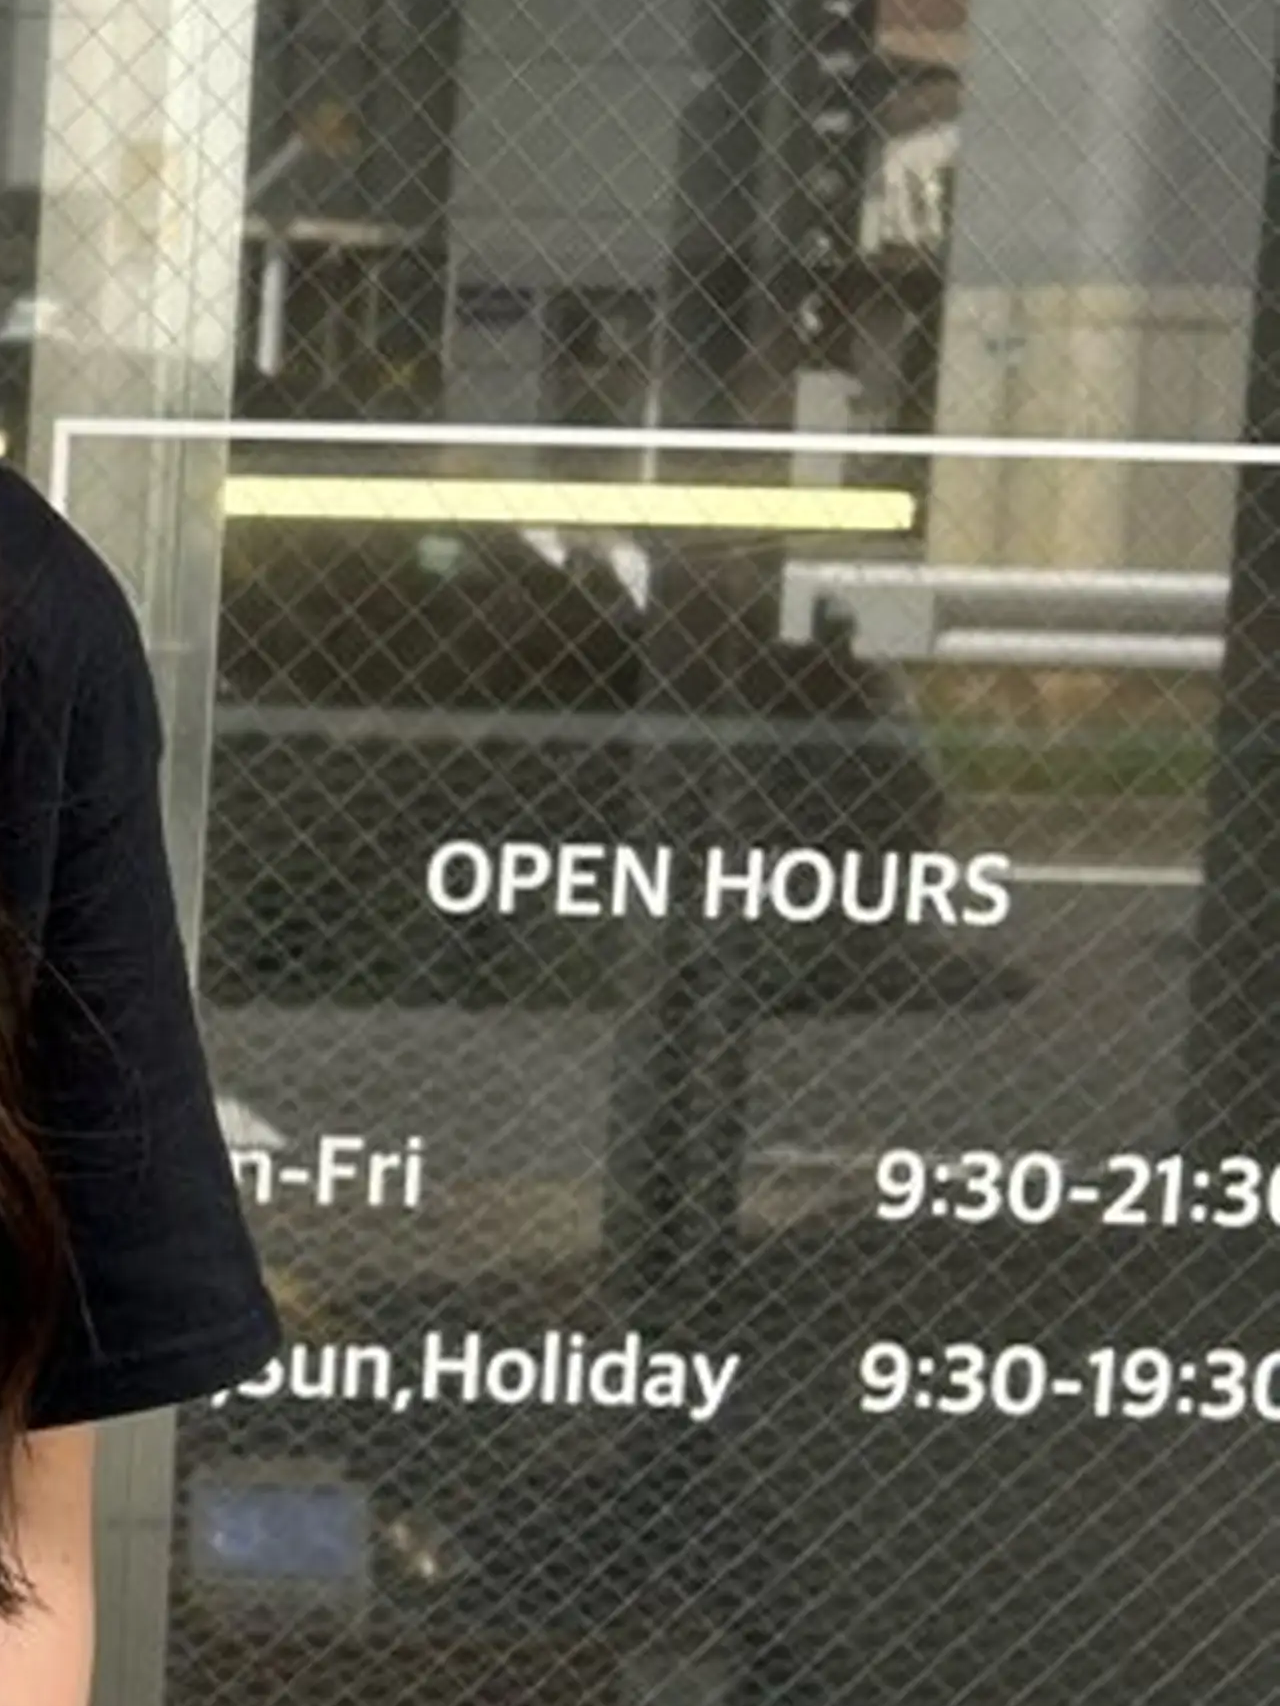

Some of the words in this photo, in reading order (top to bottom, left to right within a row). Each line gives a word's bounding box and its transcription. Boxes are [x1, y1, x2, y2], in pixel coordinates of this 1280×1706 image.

[425, 840, 672, 918] OPEN
[703, 847, 1012, 926] HOURS
[875, 1147, 1280, 1229] 9:30-21:3
